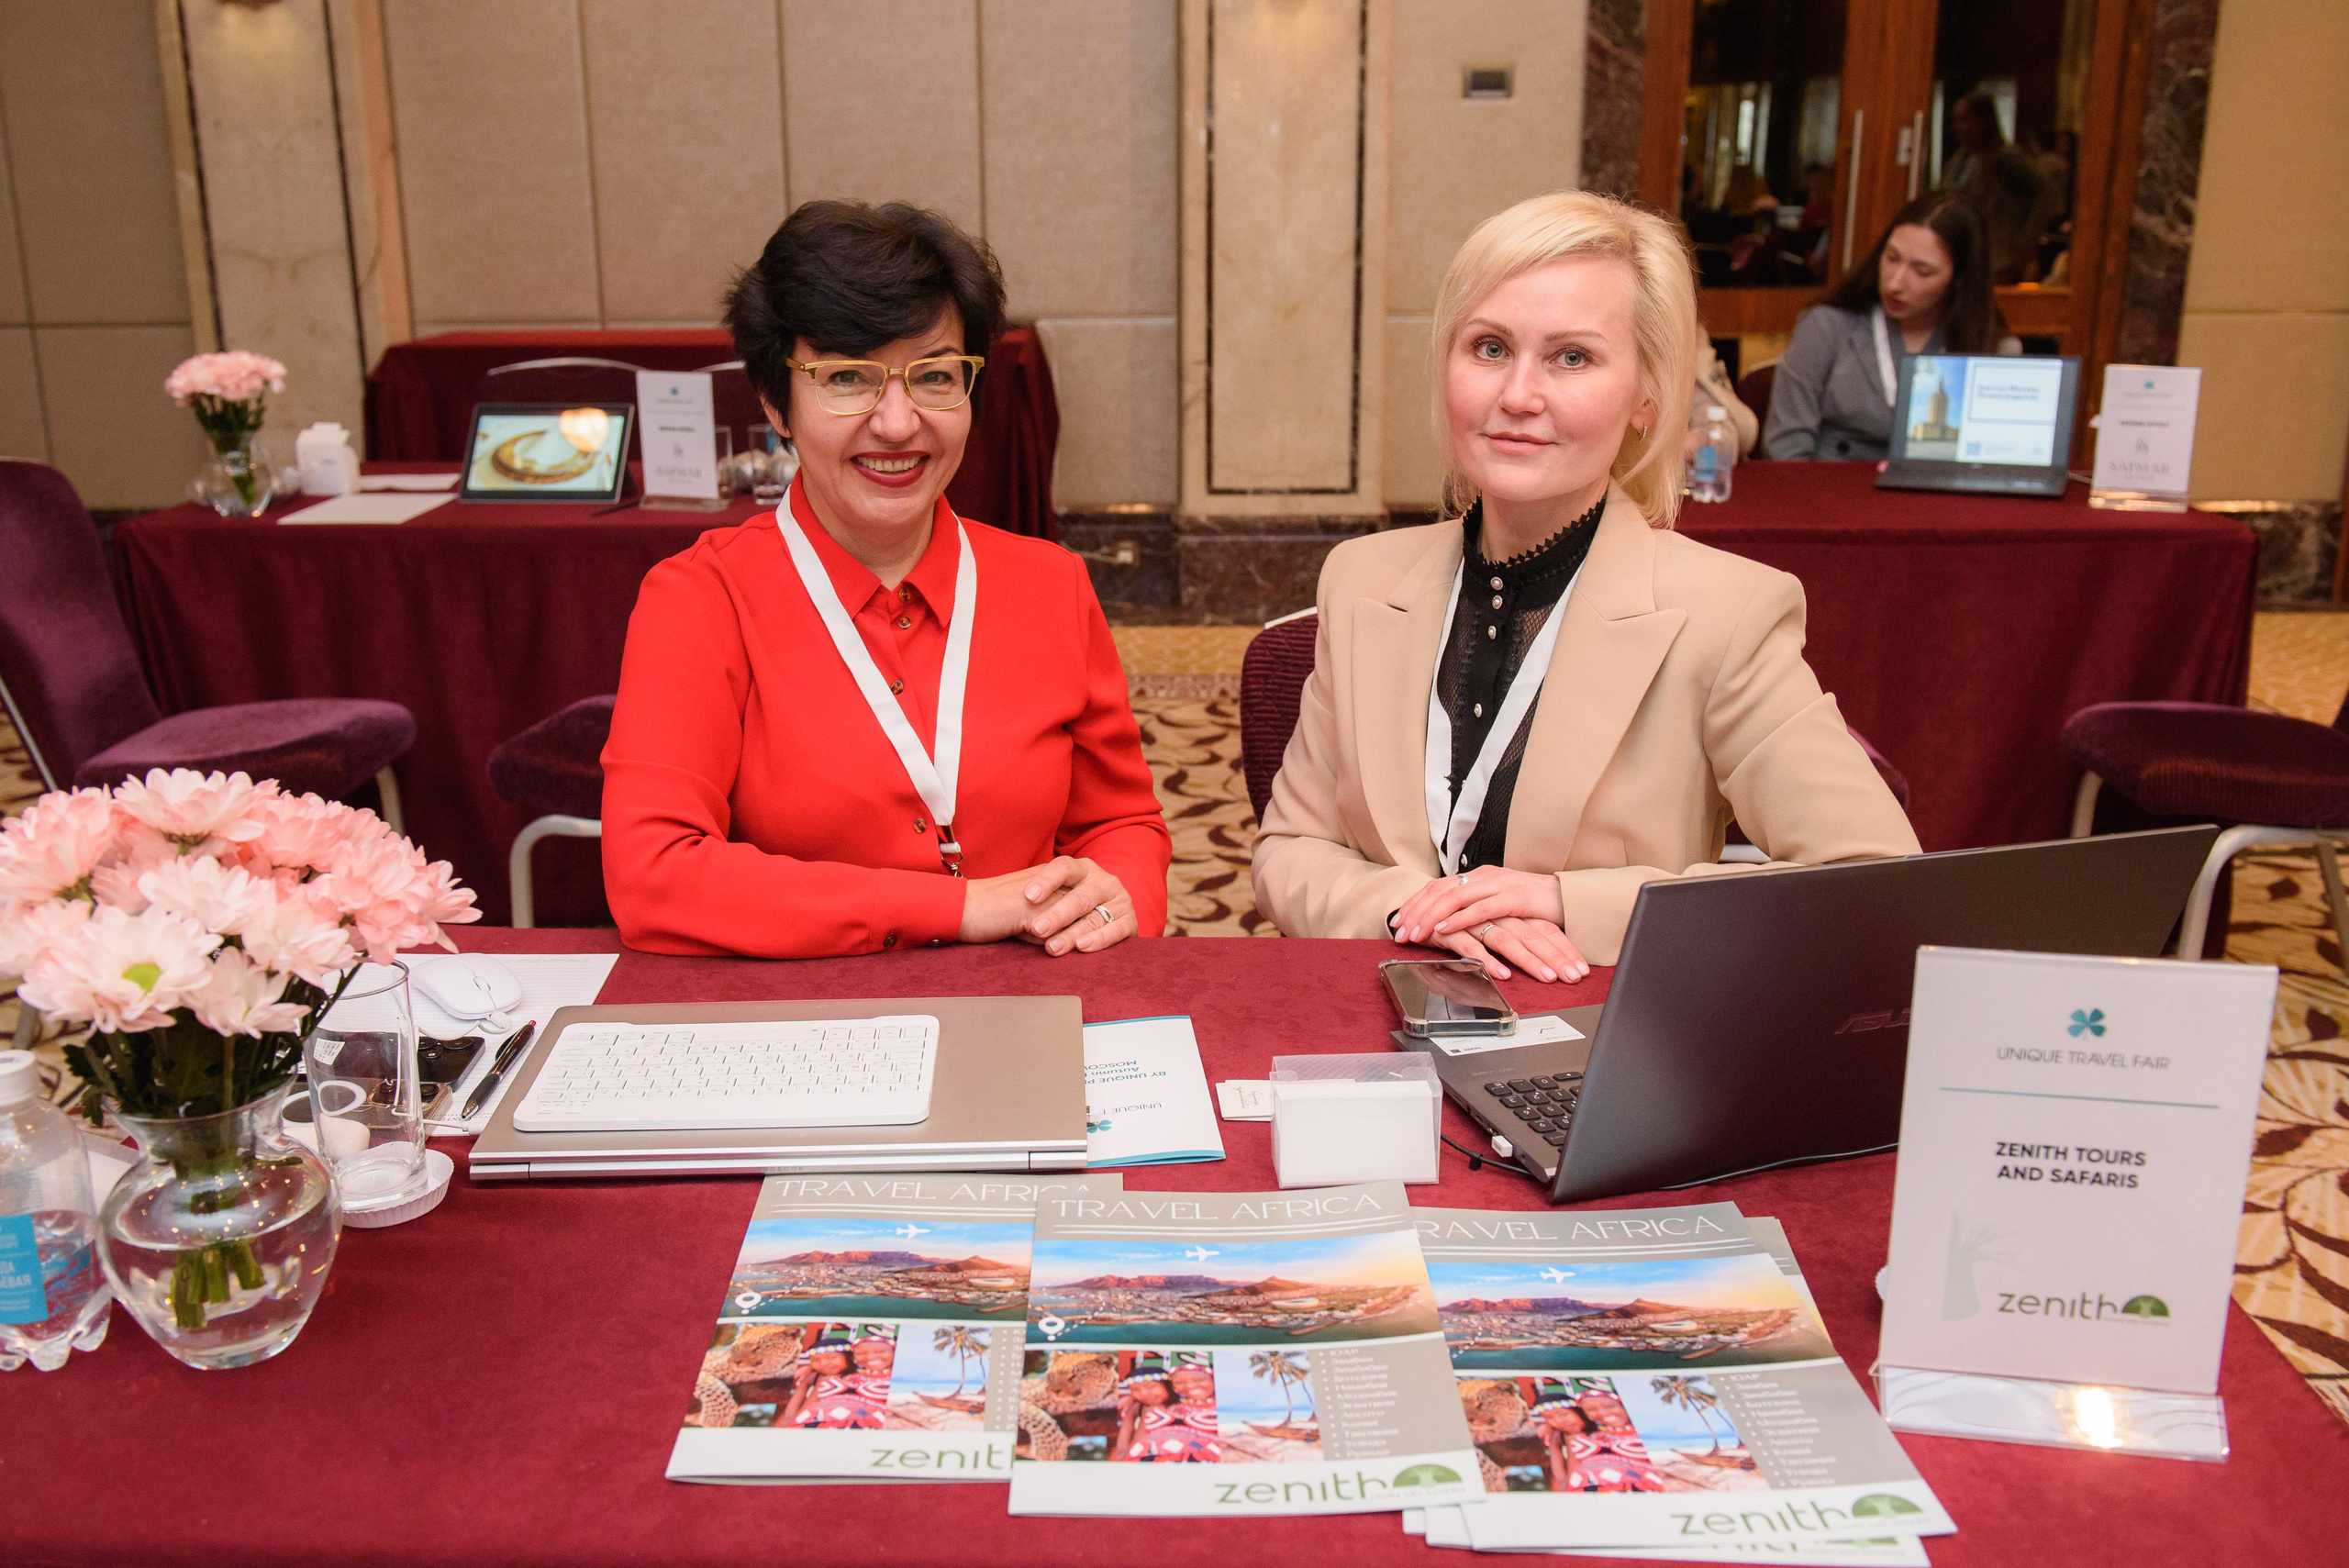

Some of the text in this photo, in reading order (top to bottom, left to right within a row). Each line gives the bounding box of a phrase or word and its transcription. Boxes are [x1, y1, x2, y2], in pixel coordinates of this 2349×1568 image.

[1996, 1046, 2171, 1071] UNIQUE TRAVEL FAIR
[1091, 1066, 1140, 1077] Autumn
[1099, 1073, 1147, 1084] UNIQUE
[1111, 1102, 1163, 1114] UNIQUE
[1996, 1141, 2146, 1166] ZENITH TOURS
[1998, 1165, 2139, 1189] AND SAFARIS
[775, 1180, 937, 1201] TRAVEL
[1052, 1194, 1383, 1220] TRAVEL AFRICA
[1414, 1216, 1725, 1240] RAVEL AFRICA
[1998, 1292, 2119, 1321] zenith
[871, 1443, 1016, 1470] zenit
[1214, 1471, 1387, 1505] zenith
[1670, 1500, 1848, 1536] zenith
